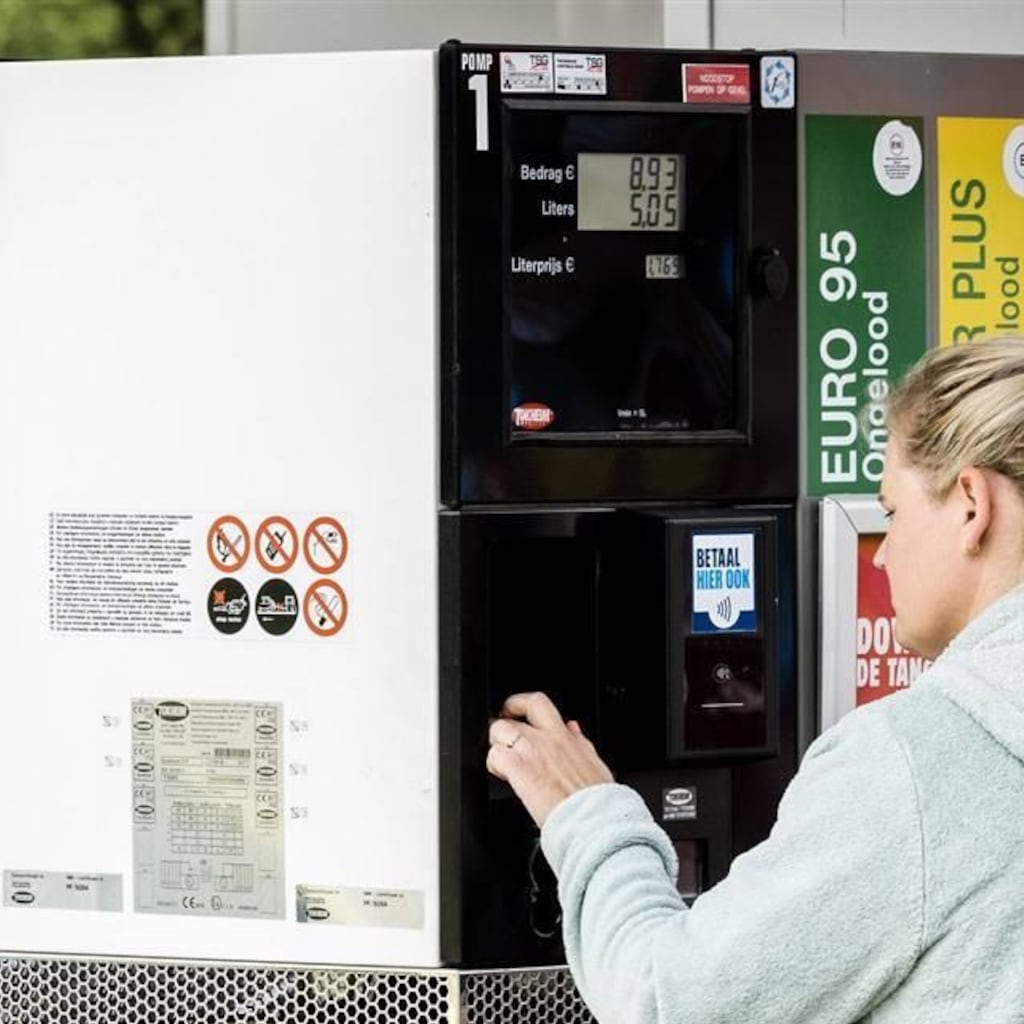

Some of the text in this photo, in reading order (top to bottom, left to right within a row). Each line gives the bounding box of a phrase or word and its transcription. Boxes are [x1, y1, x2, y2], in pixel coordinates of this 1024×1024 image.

[461, 53, 493, 71] POMP
[530, 55, 549, 66] TSG
[468, 74, 489, 151] 1
[520, 164, 575, 183] Bedrag €
[541, 200, 575, 216] Liters
[952, 178, 986, 299] PLUS
[511, 256, 575, 276] Literprijs €
[995, 256, 1020, 329] lood
[819, 230, 858, 483] EURO 95
[696, 548, 740, 568] BETAAL
[696, 569, 750, 589] HIER OOK
[857, 658, 880, 688] DE
